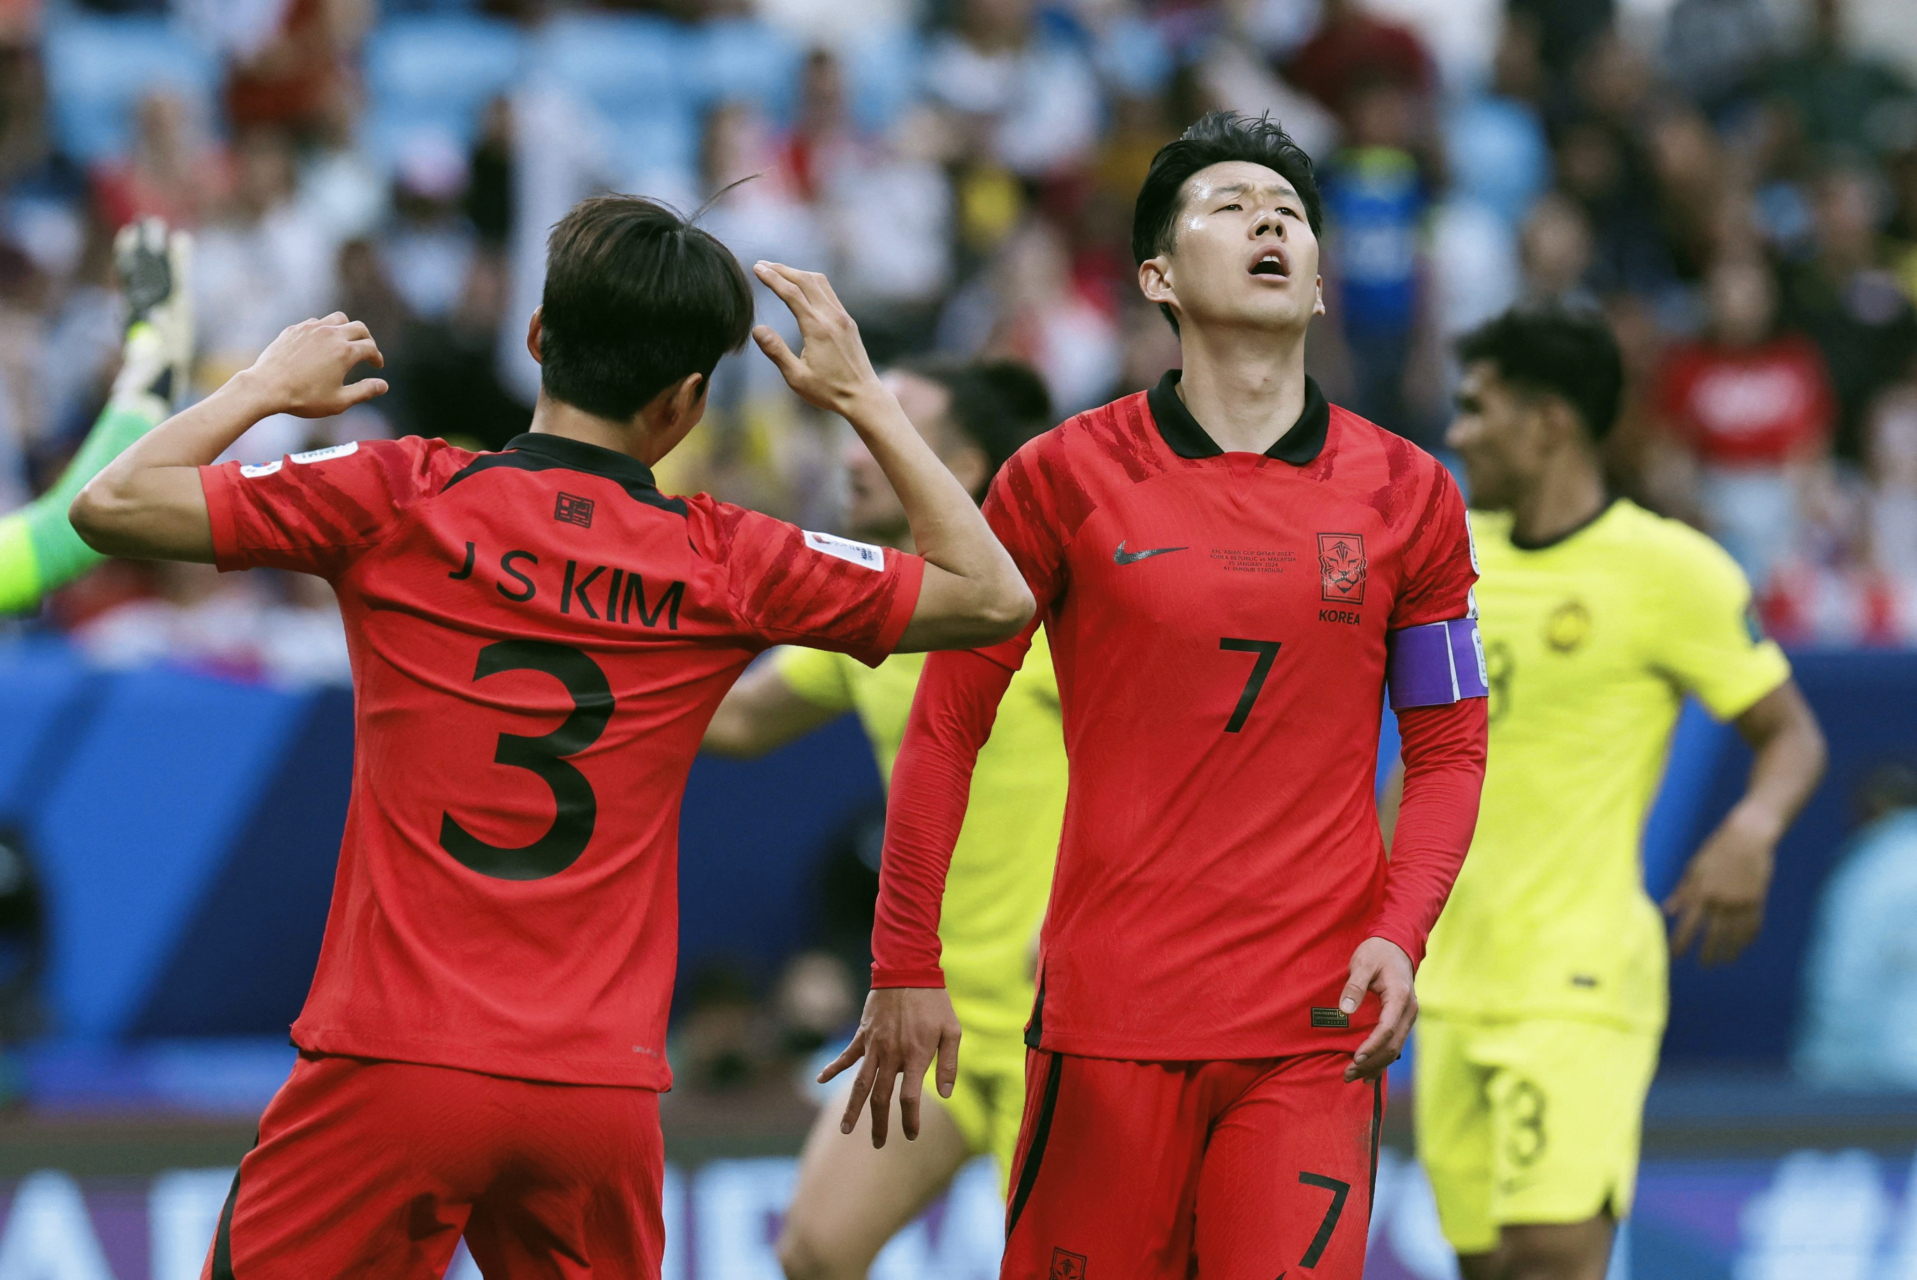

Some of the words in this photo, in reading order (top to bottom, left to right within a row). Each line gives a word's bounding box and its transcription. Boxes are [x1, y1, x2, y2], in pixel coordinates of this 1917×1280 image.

[448, 541, 475, 580] J
[496, 550, 539, 602] S
[560, 559, 686, 630] KIM
[1319, 609, 1361, 625] KOREA
[1219, 637, 1283, 733] 7
[439, 639, 616, 881] 3
[1505, 1079, 1548, 1169] 3
[1298, 1171, 1351, 1269] 7
